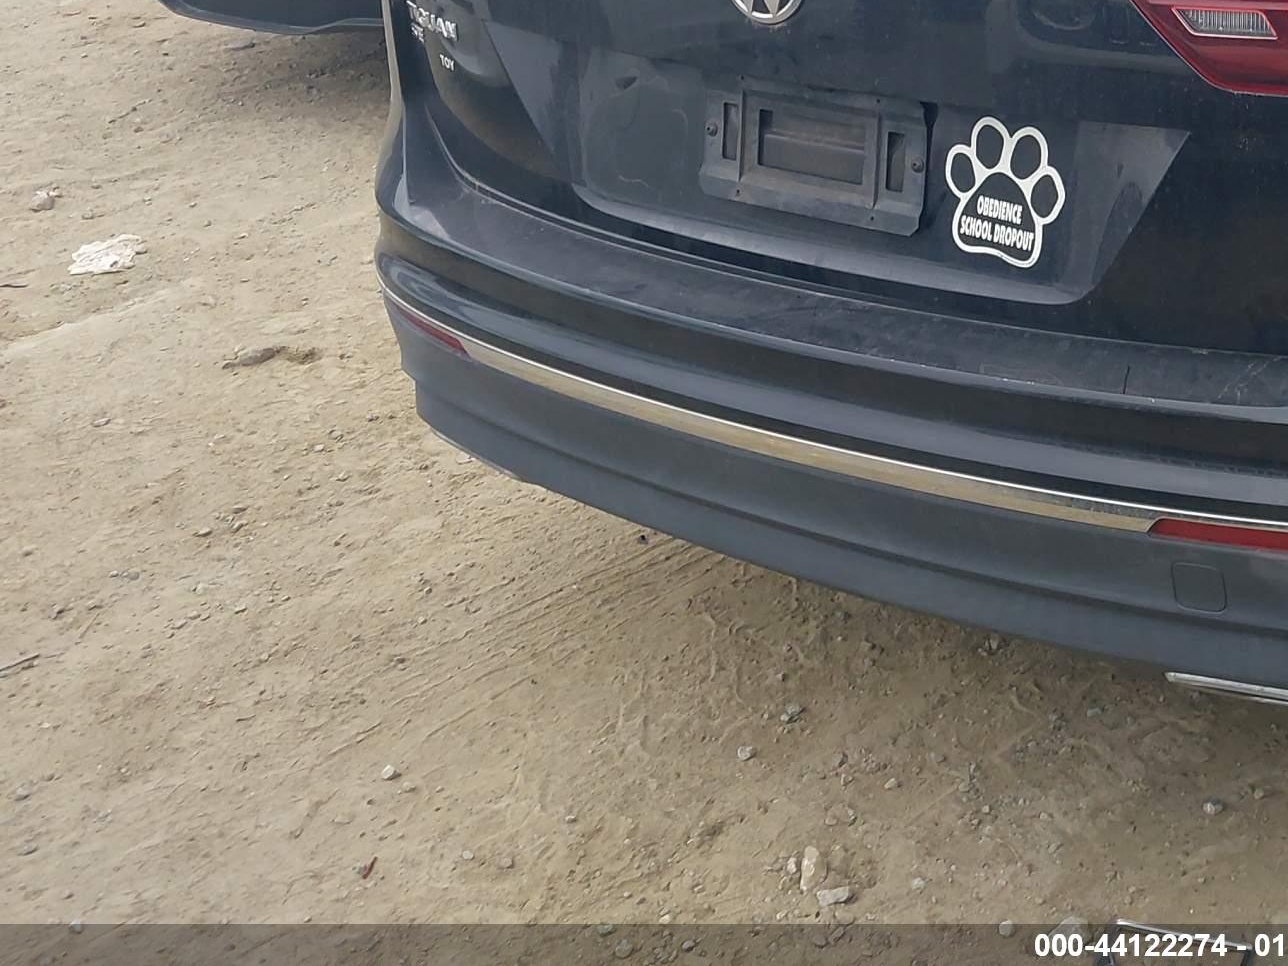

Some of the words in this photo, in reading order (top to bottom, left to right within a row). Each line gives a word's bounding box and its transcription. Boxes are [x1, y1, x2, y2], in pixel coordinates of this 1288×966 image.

[976, 195, 1023, 224] OBEDIENCE
[961, 216, 992, 242] SCHOOL
[993, 225, 1034, 251] DROPOUT
